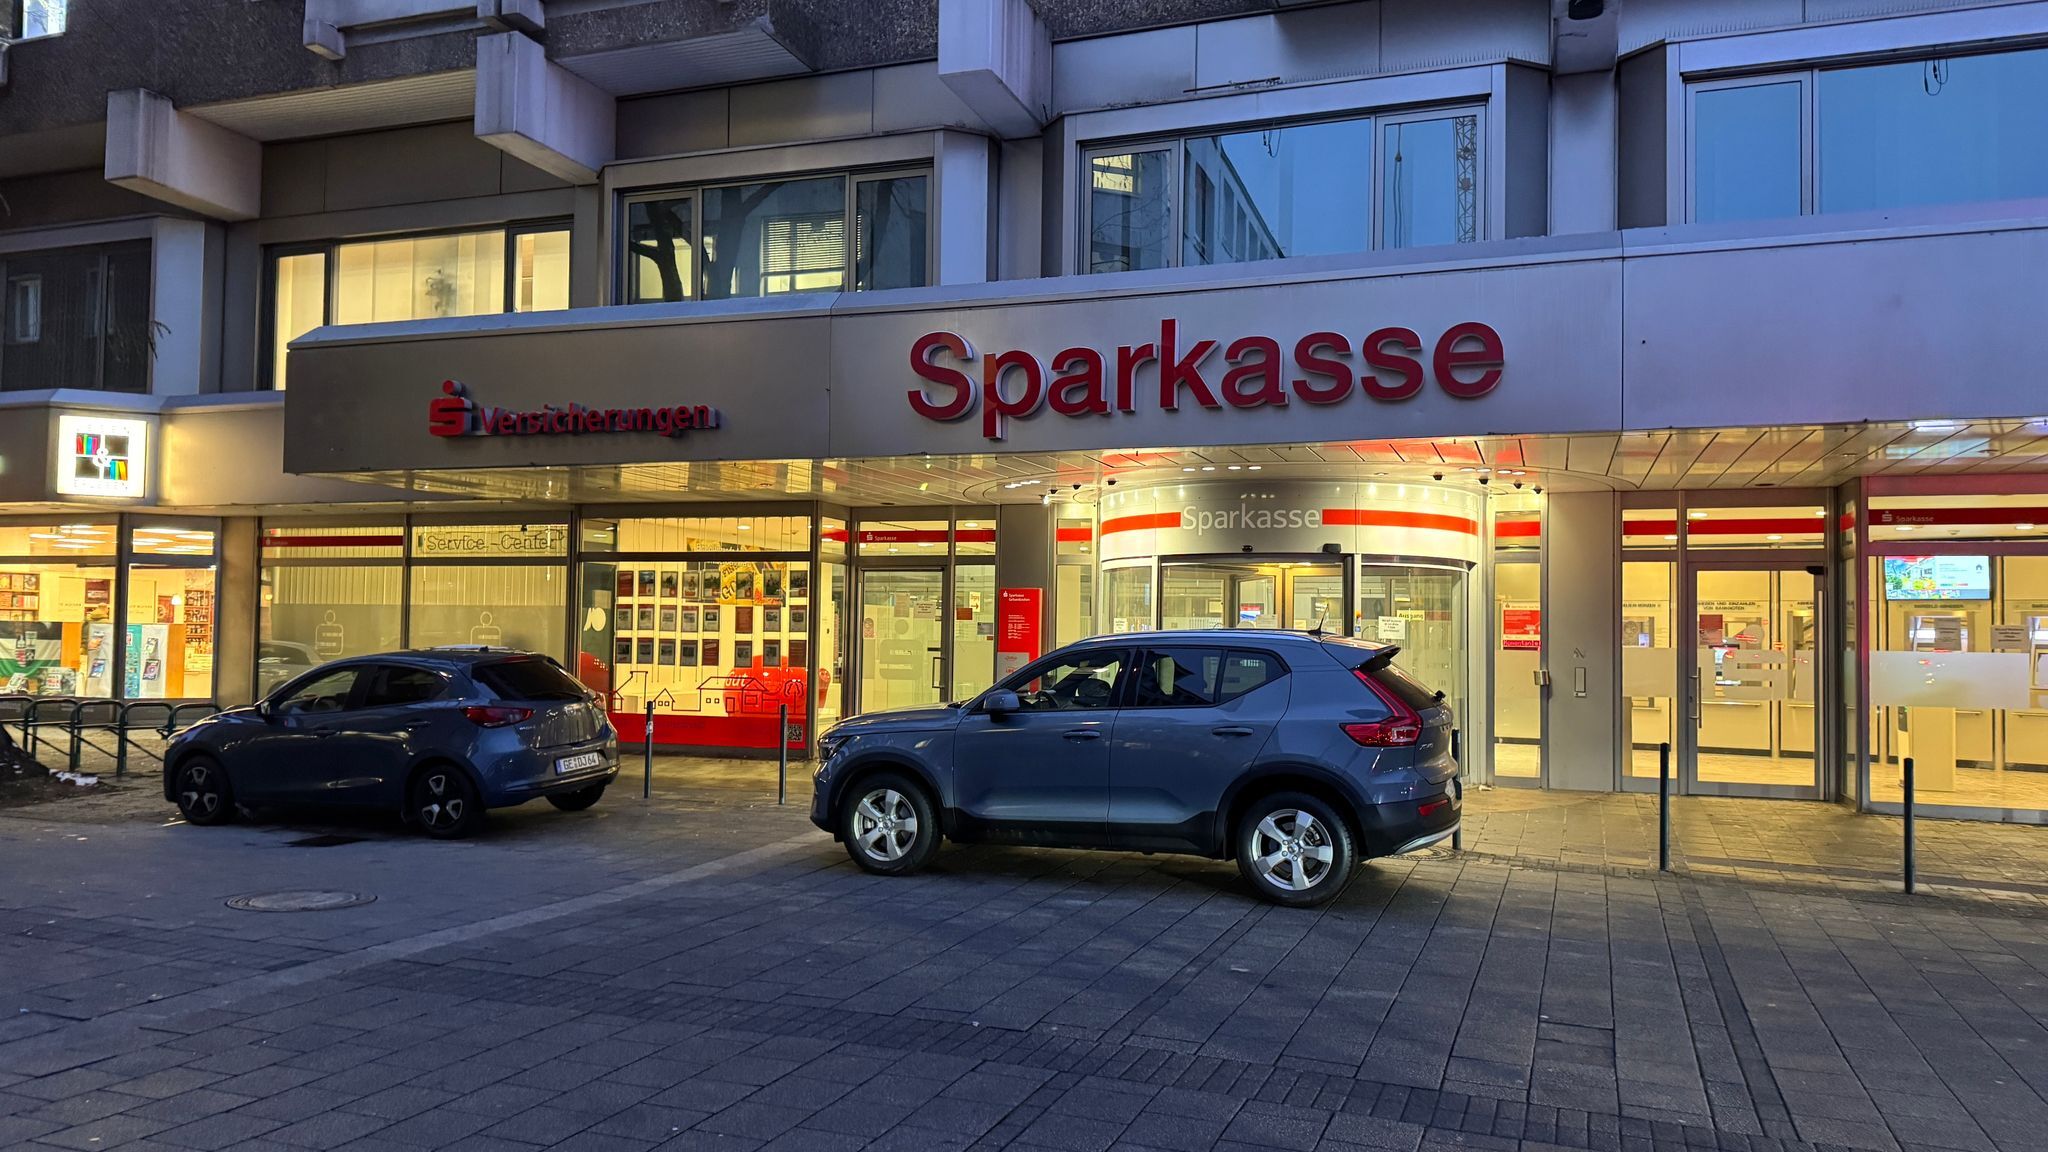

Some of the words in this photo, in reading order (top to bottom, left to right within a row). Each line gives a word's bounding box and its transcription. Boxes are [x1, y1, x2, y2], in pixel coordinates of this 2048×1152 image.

[908, 318, 1505, 440] Sparkasse
[480, 402, 714, 437] Versicherungen
[1182, 503, 1320, 536] Sparkasse
[1895, 515, 1935, 523] Sparkasse
